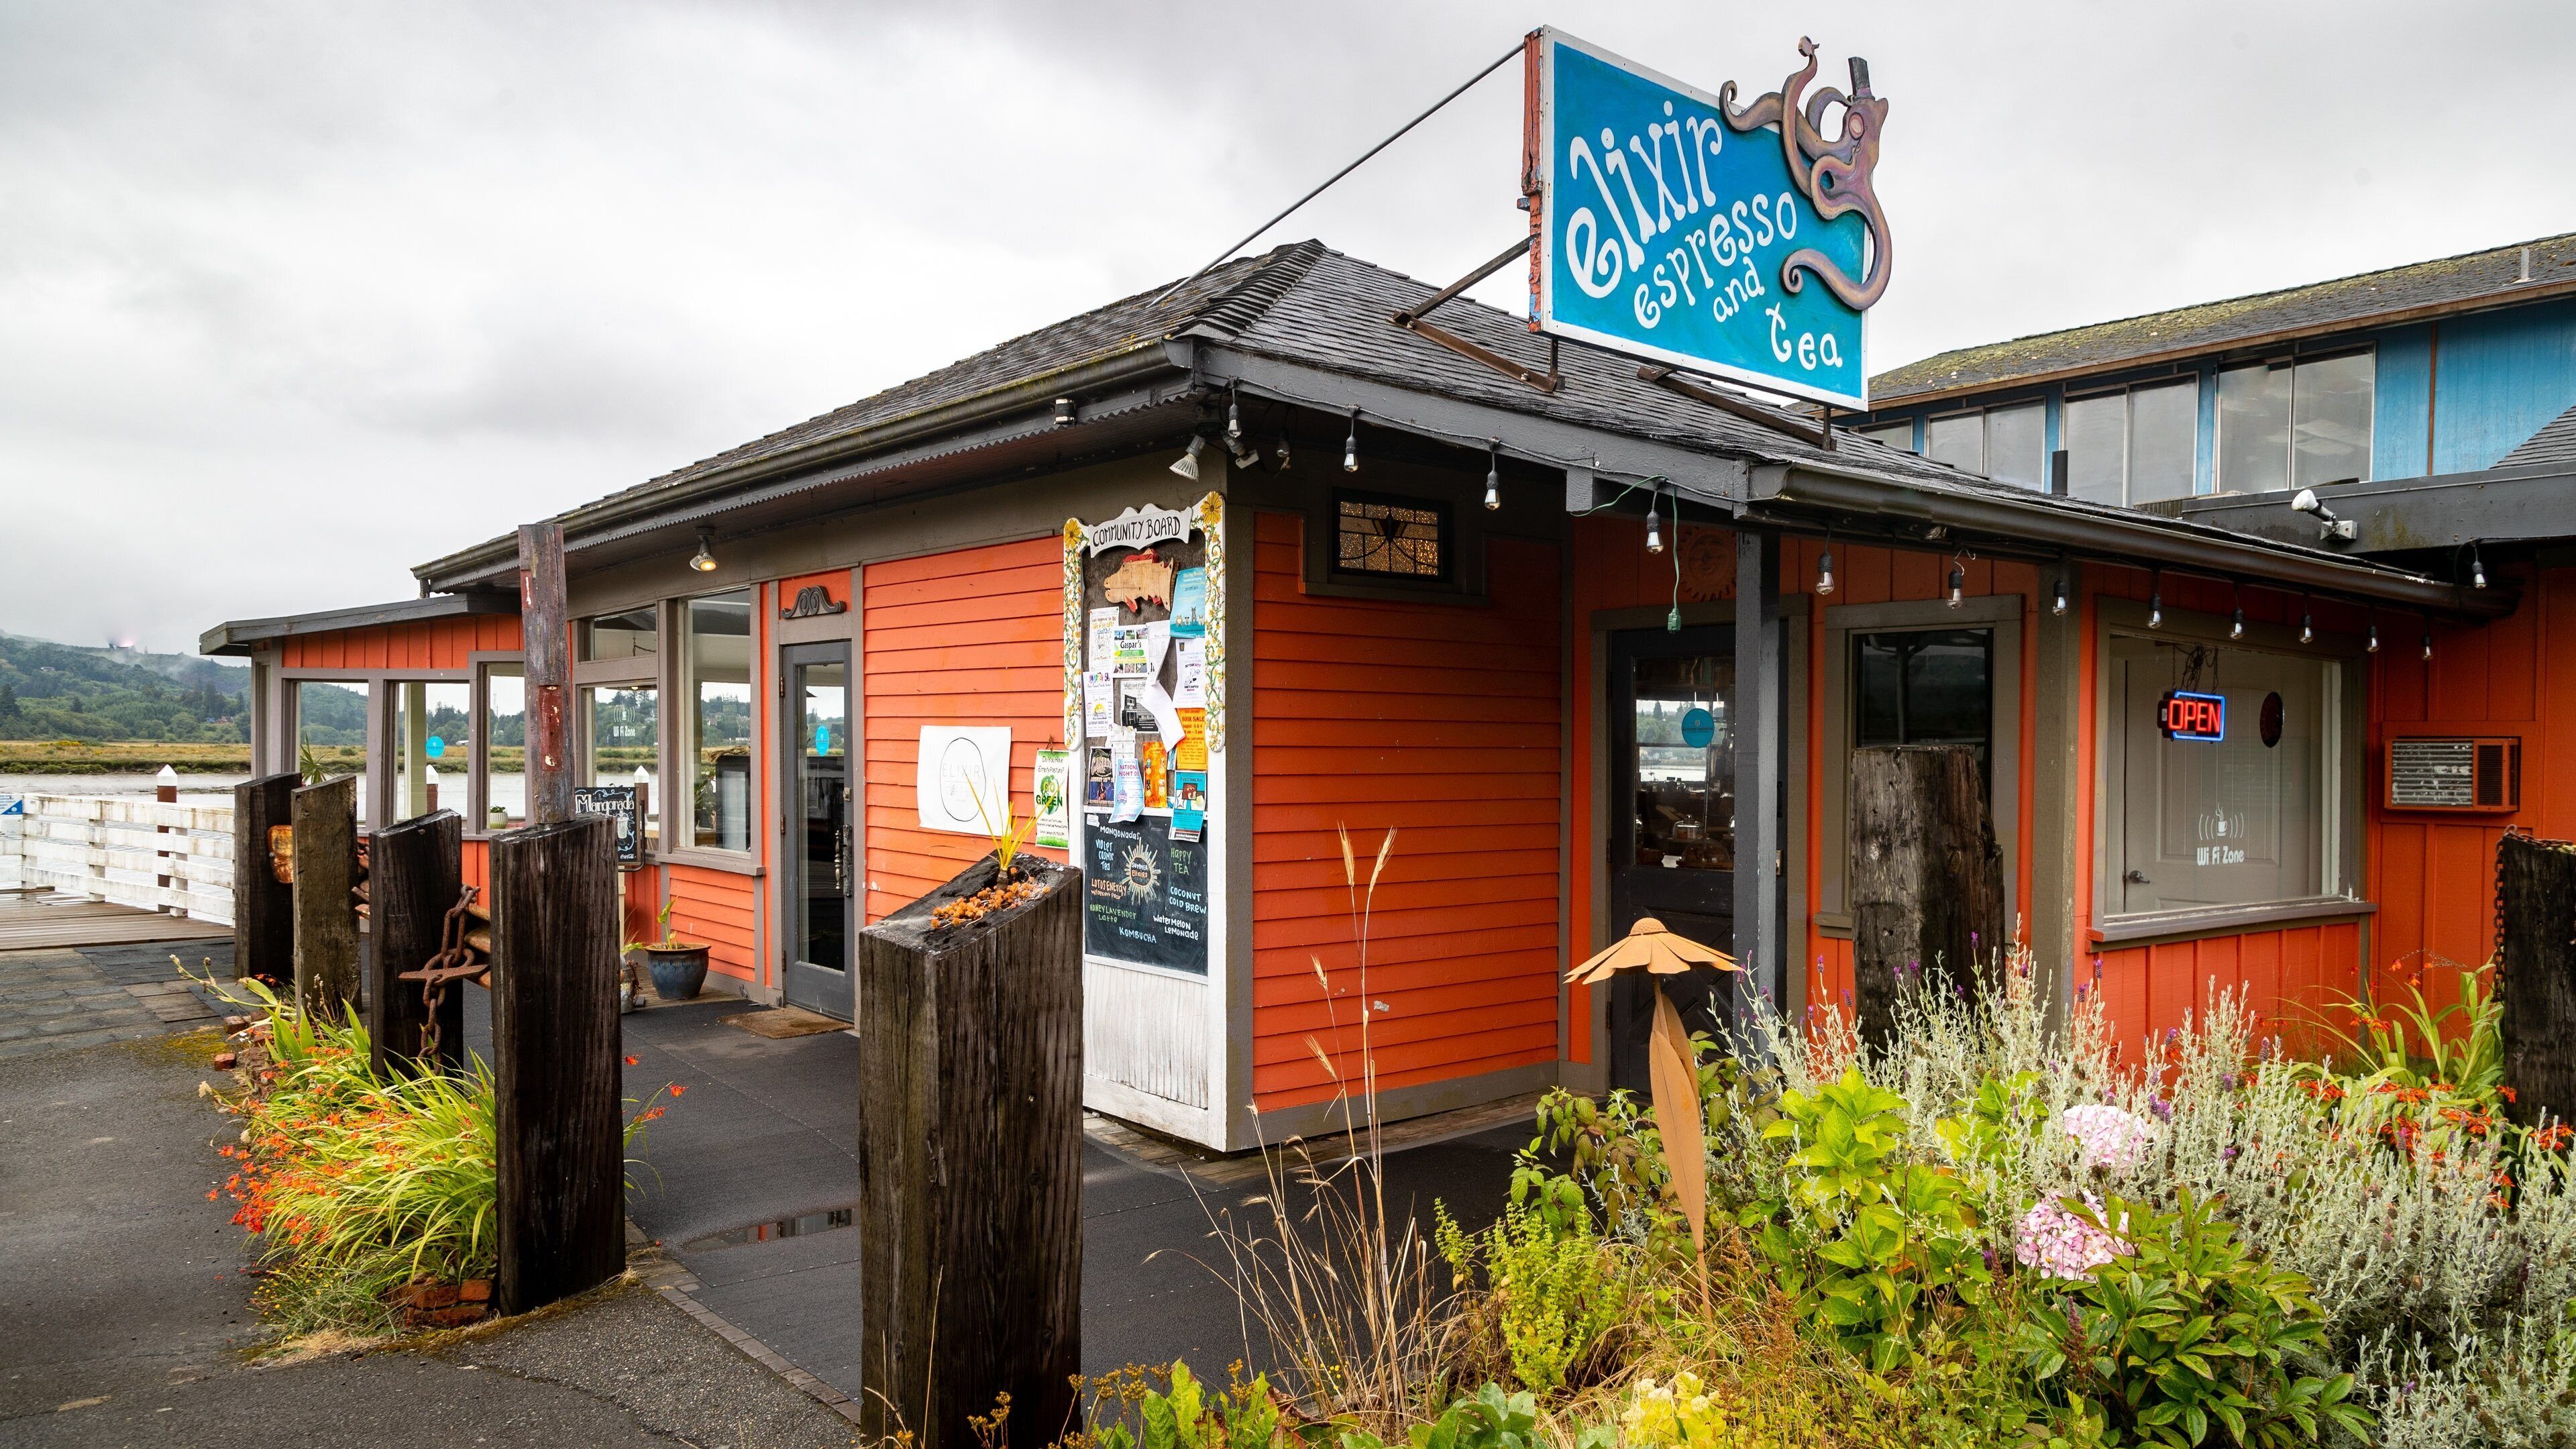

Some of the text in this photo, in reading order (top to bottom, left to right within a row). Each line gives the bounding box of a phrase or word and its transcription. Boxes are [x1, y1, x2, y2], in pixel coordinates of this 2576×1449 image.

[1566, 100, 1723, 299] elixir
[1633, 191, 1798, 329] espresso
[1713, 256, 1765, 323] and
[1765, 302, 1843, 370] tea
[1093, 516, 1181, 547] COMMUNITY BOARD
[1120, 640, 1142, 650] Gaspar's
[2168, 699, 2222, 733] OPEN
[625, 725, 636, 737] Zone
[942, 763, 980, 779] ELIXIR
[1036, 794, 1063, 807] GREEN
[1098, 851, 1114, 861] COSMIC
[2197, 845, 2245, 866] Wi Fi Zone
[1101, 861, 1110, 871] Tea
[1132, 862, 1148, 871] SUMMER
[1173, 862, 1189, 875] TEA
[1170, 886, 1201, 902] COCONUT
[1089, 904, 1105, 913] HONEY
[1119, 926, 1157, 944] KOMBUCHA
